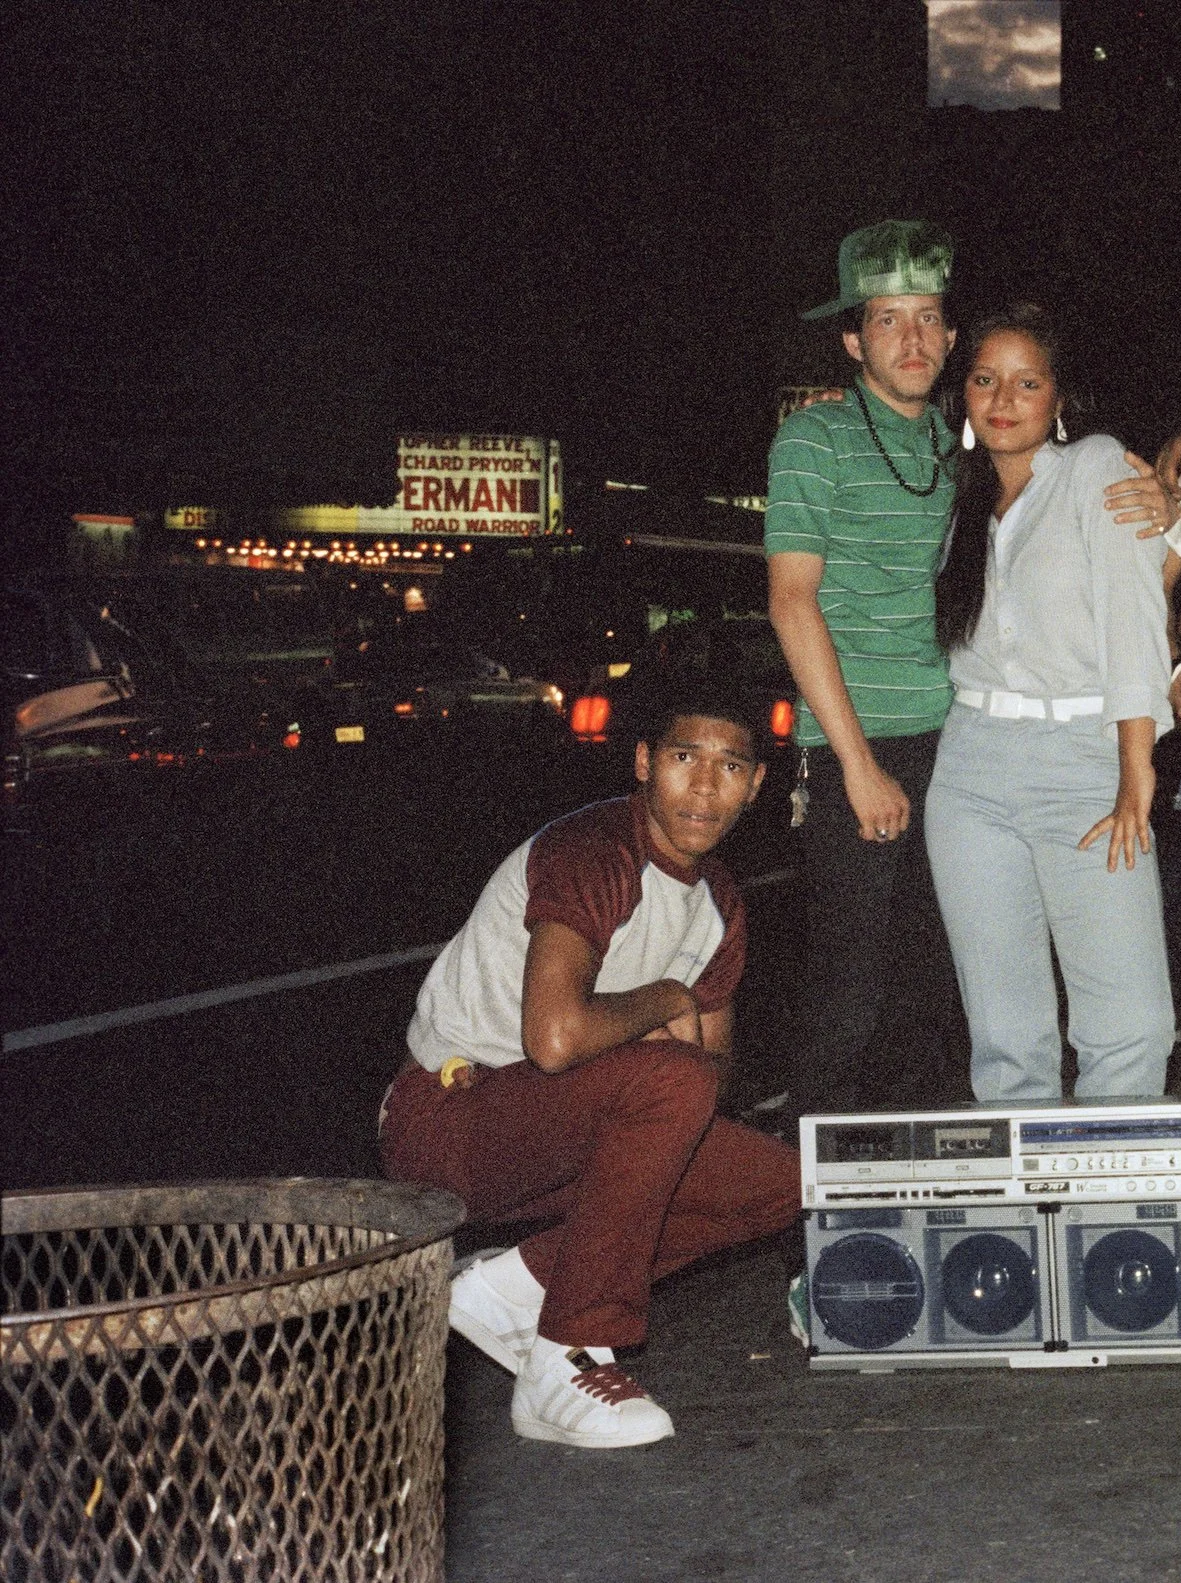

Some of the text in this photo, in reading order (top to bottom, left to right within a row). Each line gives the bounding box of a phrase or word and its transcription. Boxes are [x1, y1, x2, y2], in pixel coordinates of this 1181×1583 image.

[469, 457, 522, 473] PRYOR
[399, 475, 517, 513] ERMAN
[412, 517, 540, 535] ROAD WARRIOR
